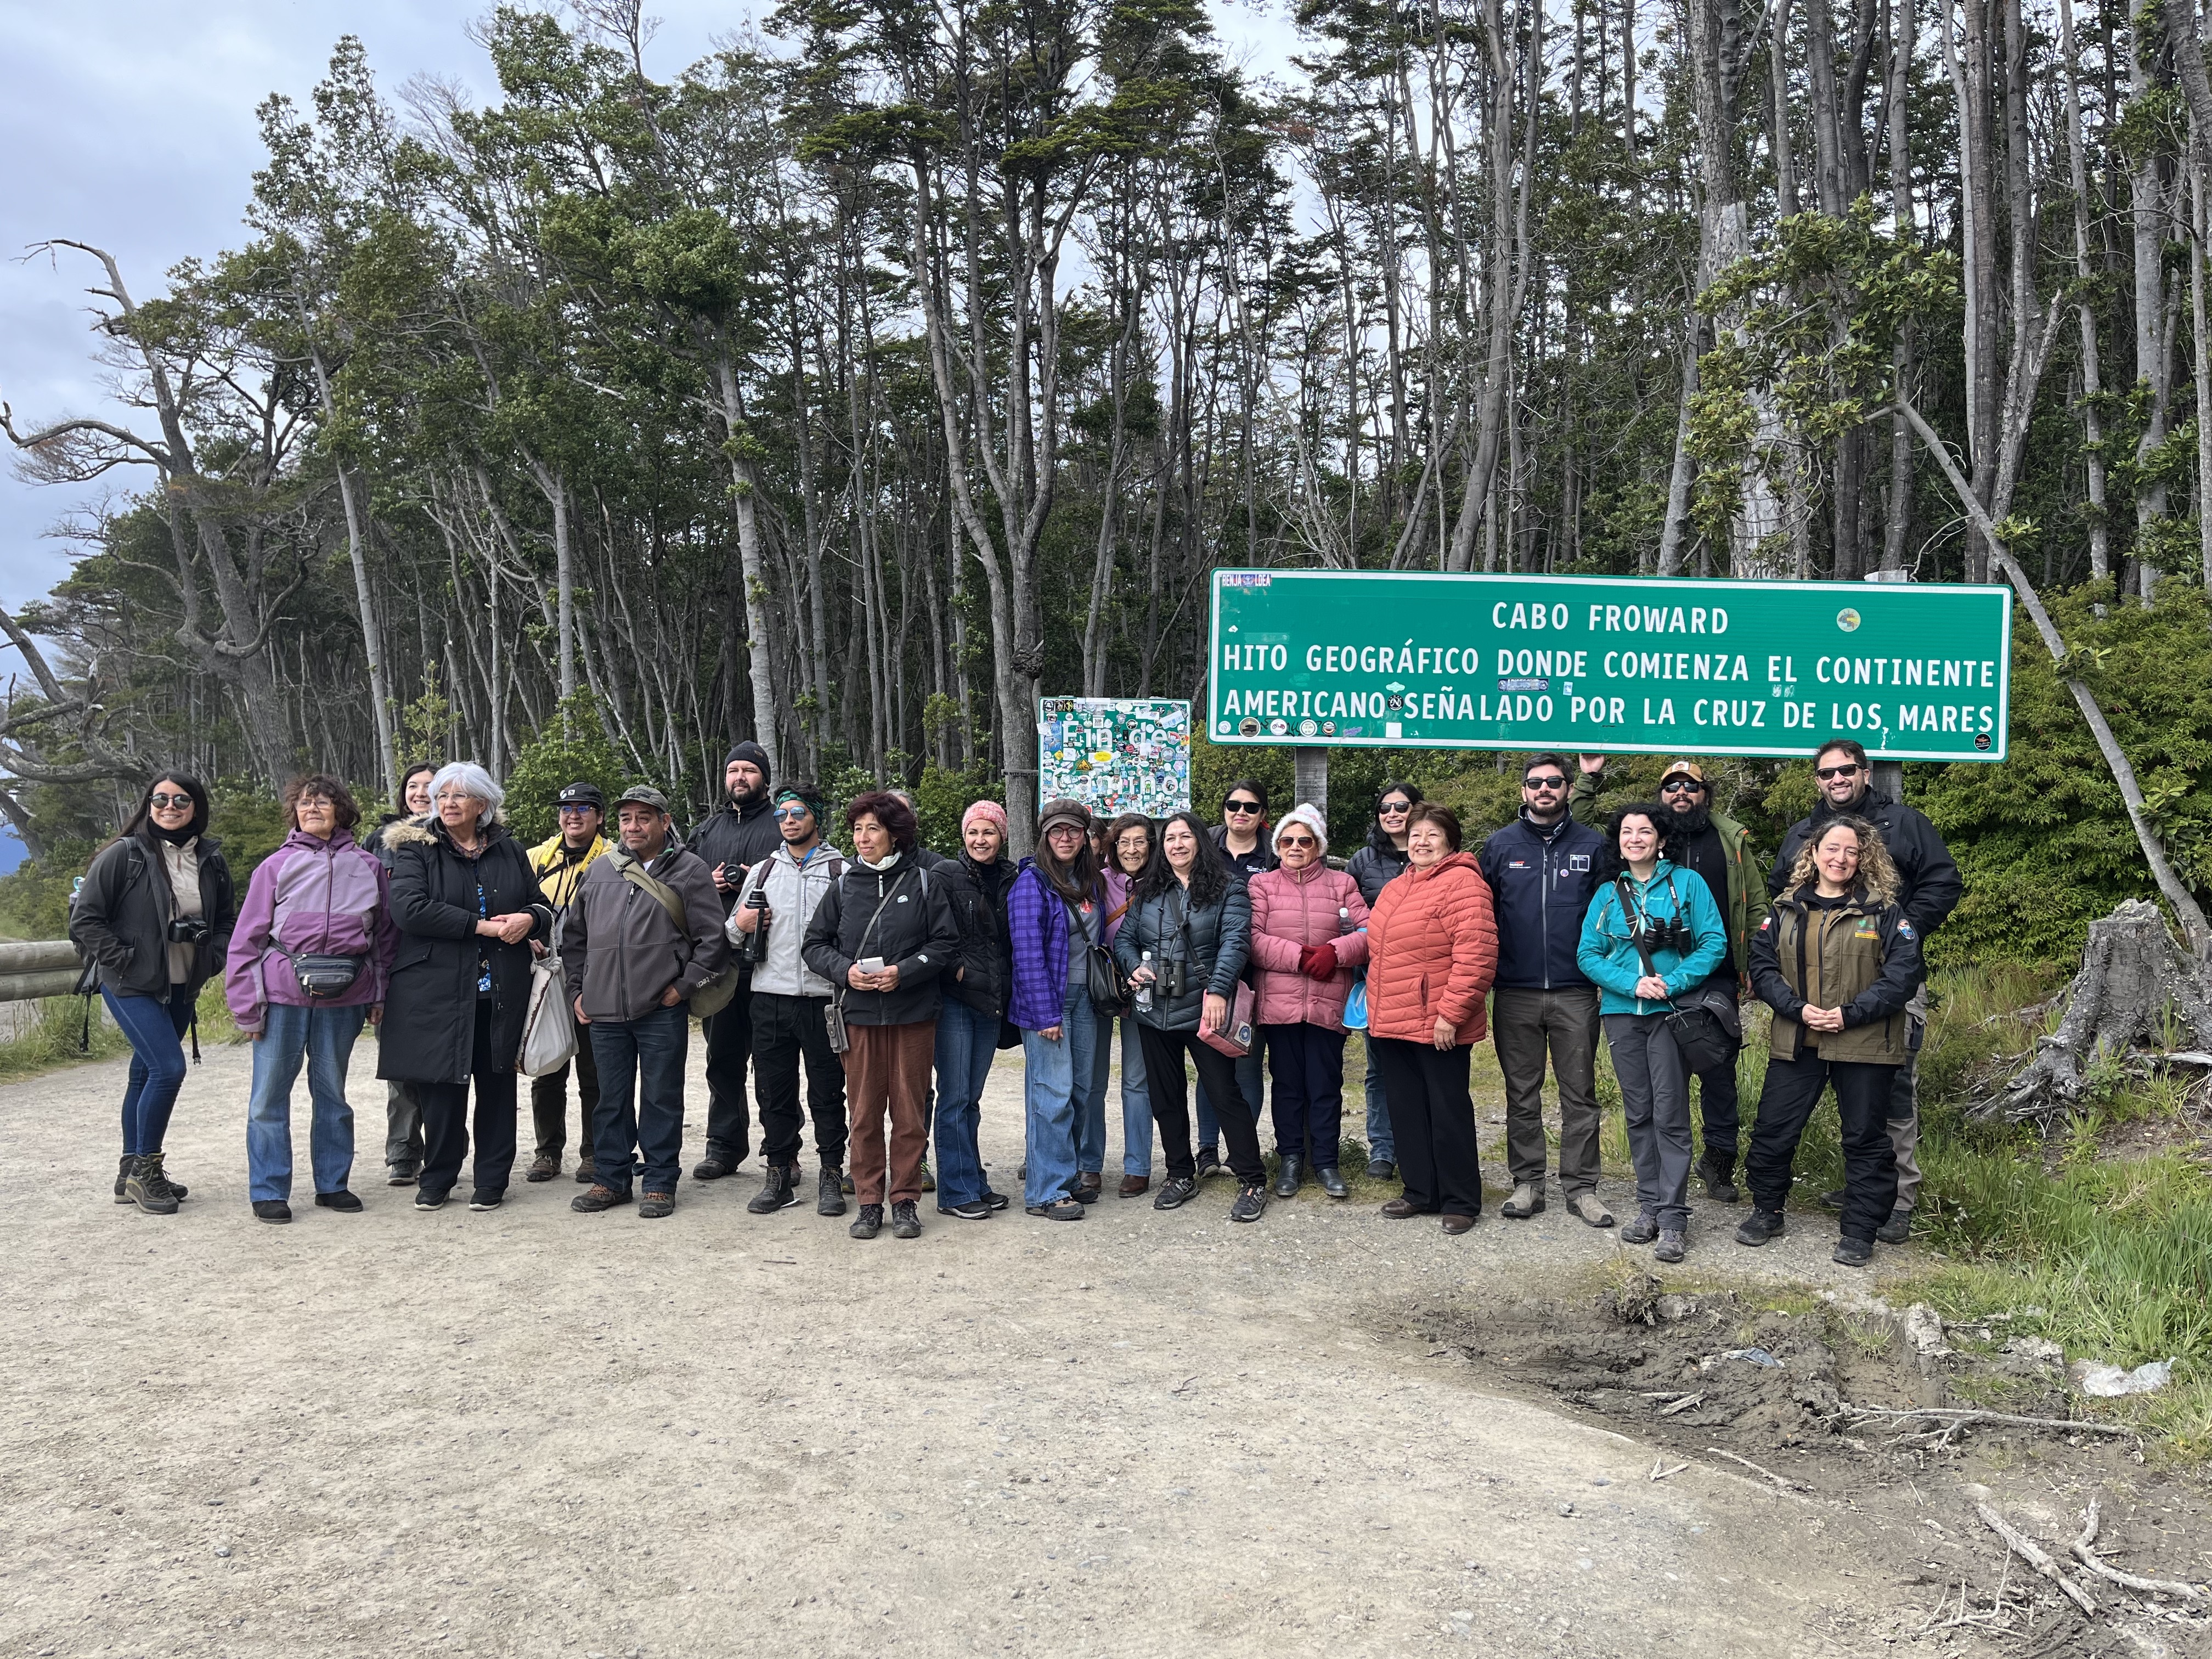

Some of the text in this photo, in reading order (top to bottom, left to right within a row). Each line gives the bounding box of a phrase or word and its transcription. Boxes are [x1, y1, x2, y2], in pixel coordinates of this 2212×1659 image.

[1492, 602, 1728, 634] CABO FROWARD
[1224, 638, 1994, 687] HITO GEOGRÁFICO DONDE COMIENZA EL CONTINENTE
[1223, 690, 1384, 718] AMERICANO
[1404, 685, 1553, 721] SEÑALADO
[1571, 696, 1625, 724] POR
[1644, 698, 1675, 725] LA
[1694, 699, 1766, 727] CRUZ
[1784, 702, 1816, 729] DE
[1832, 703, 1882, 730] LOS
[1899, 704, 1993, 732] MARES
[1063, 720, 1167, 748] Fin de
[1052, 768, 1178, 795] Camino
[696, 977, 710, 989] tech
